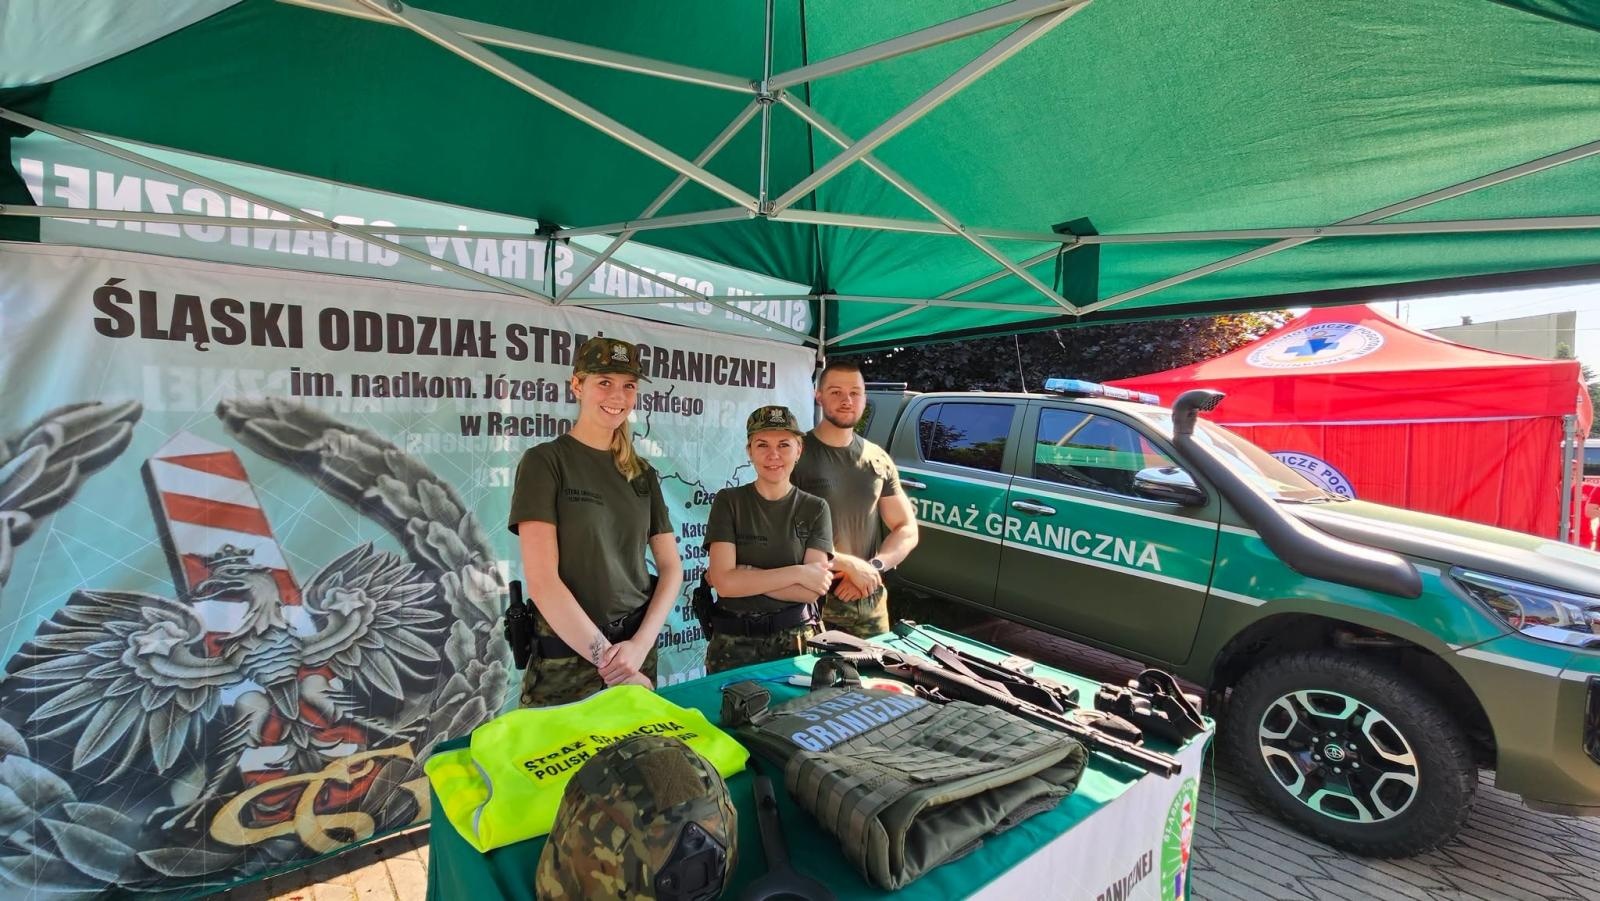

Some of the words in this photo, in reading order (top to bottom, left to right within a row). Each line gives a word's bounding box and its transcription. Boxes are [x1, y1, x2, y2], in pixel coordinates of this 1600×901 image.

[93, 278, 303, 351] ŚLĄSKI
[319, 308, 496, 358] ODDZIAŁ
[636, 343, 775, 389] GRANICZNEJ
[290, 366, 342, 397] im.
[351, 372, 477, 399] nadkom.
[483, 373, 558, 402] Józefa
[460, 415, 481, 436] w
[487, 411, 574, 437] Racibo
[908, 497, 979, 530] STRAŻ
[985, 513, 1162, 571] GRANICZNA
[791, 695, 928, 752] GRANICZNA
[534, 751, 591, 780] POLISH
[1097, 849, 1152, 901] ANICZNEJ
